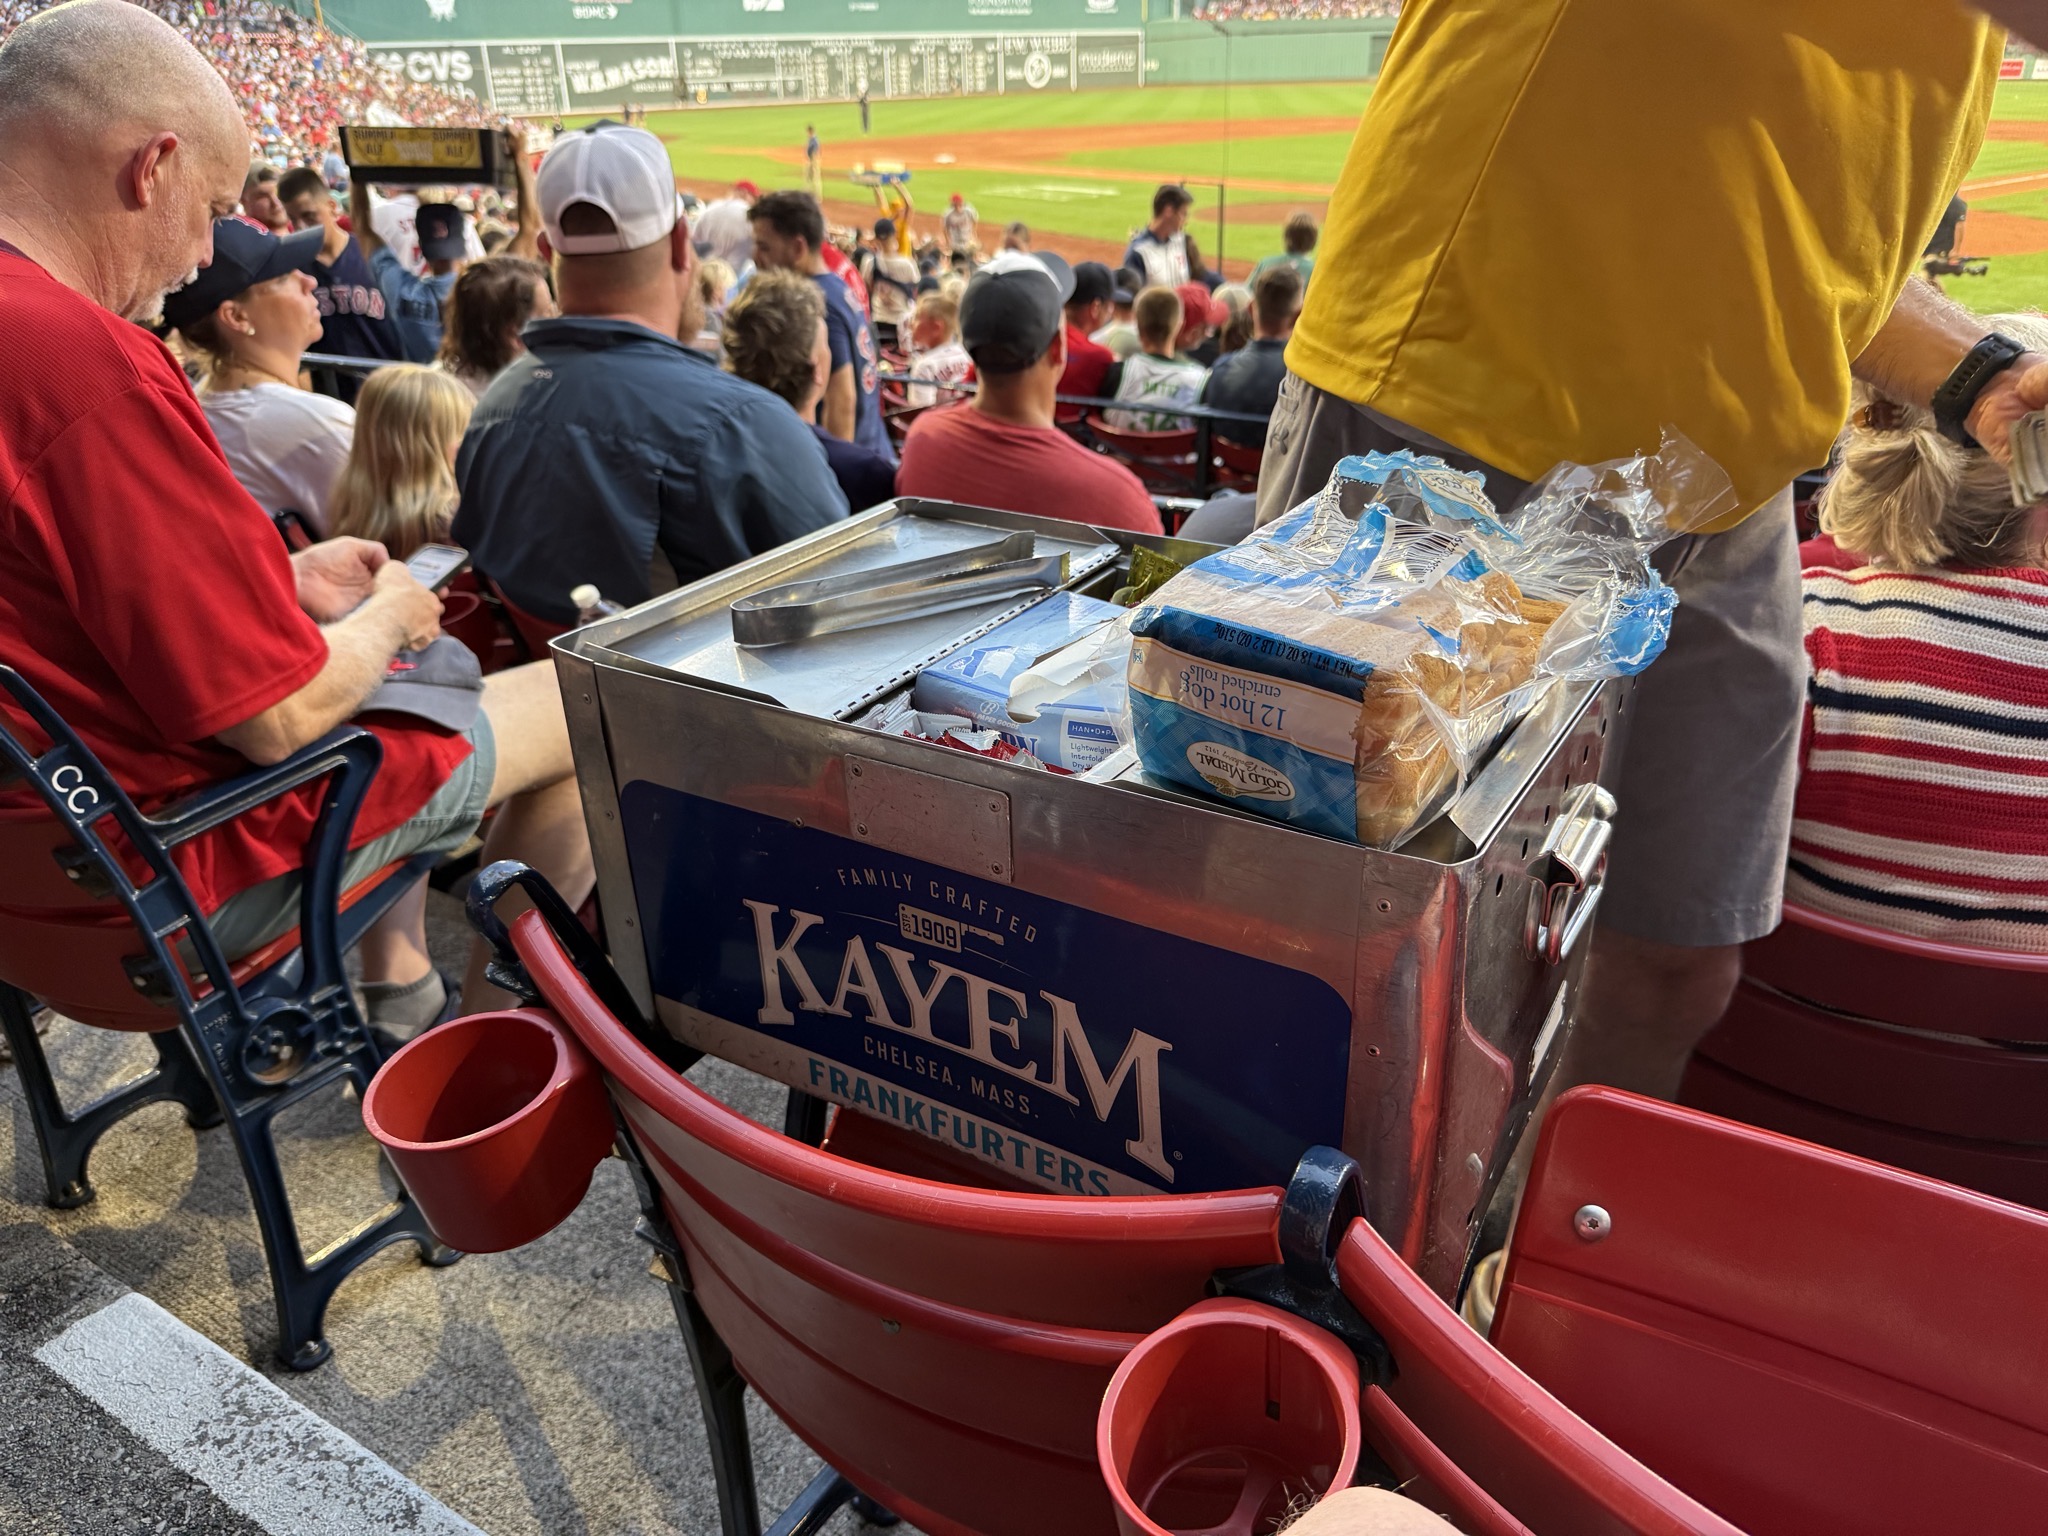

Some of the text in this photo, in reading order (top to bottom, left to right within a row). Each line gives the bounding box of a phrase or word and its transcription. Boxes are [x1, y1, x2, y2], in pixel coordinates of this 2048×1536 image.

[407, 51, 473, 82] CVS
[313, 284, 386, 321] STON
[1215, 622, 1236, 643] 510g
[1252, 636, 1261, 650] 2
[1261, 639, 1275, 657] LB
[1285, 645, 1300, 661] OZ
[1300, 650, 1314, 665] 18
[1314, 655, 1331, 671] WT
[1333, 660, 1354, 678] NET
[1190, 665, 1281, 698] enriched rolls
[1180, 671, 1287, 731] 12 hot dog
[976, 713, 997, 725] PAPER
[996, 719, 1020, 731] GOODS
[1069, 742, 1113, 755] Lightweight
[1070, 752, 1105, 764] Interfold
[1204, 745, 1220, 756] 1912
[1196, 751, 1291, 797] GOLD MEDAL
[1261, 766, 1278, 777] Since
[51, 765, 99, 814] CC
[837, 867, 1037, 943] FAMILY CRAFTED
[911, 913, 957, 949] 1909
[742, 898, 1174, 1184] KAYEM
[863, 1035, 1040, 1119] CHELSEA, MASS.
[807, 1057, 1112, 1196] FRANKFURTERS
